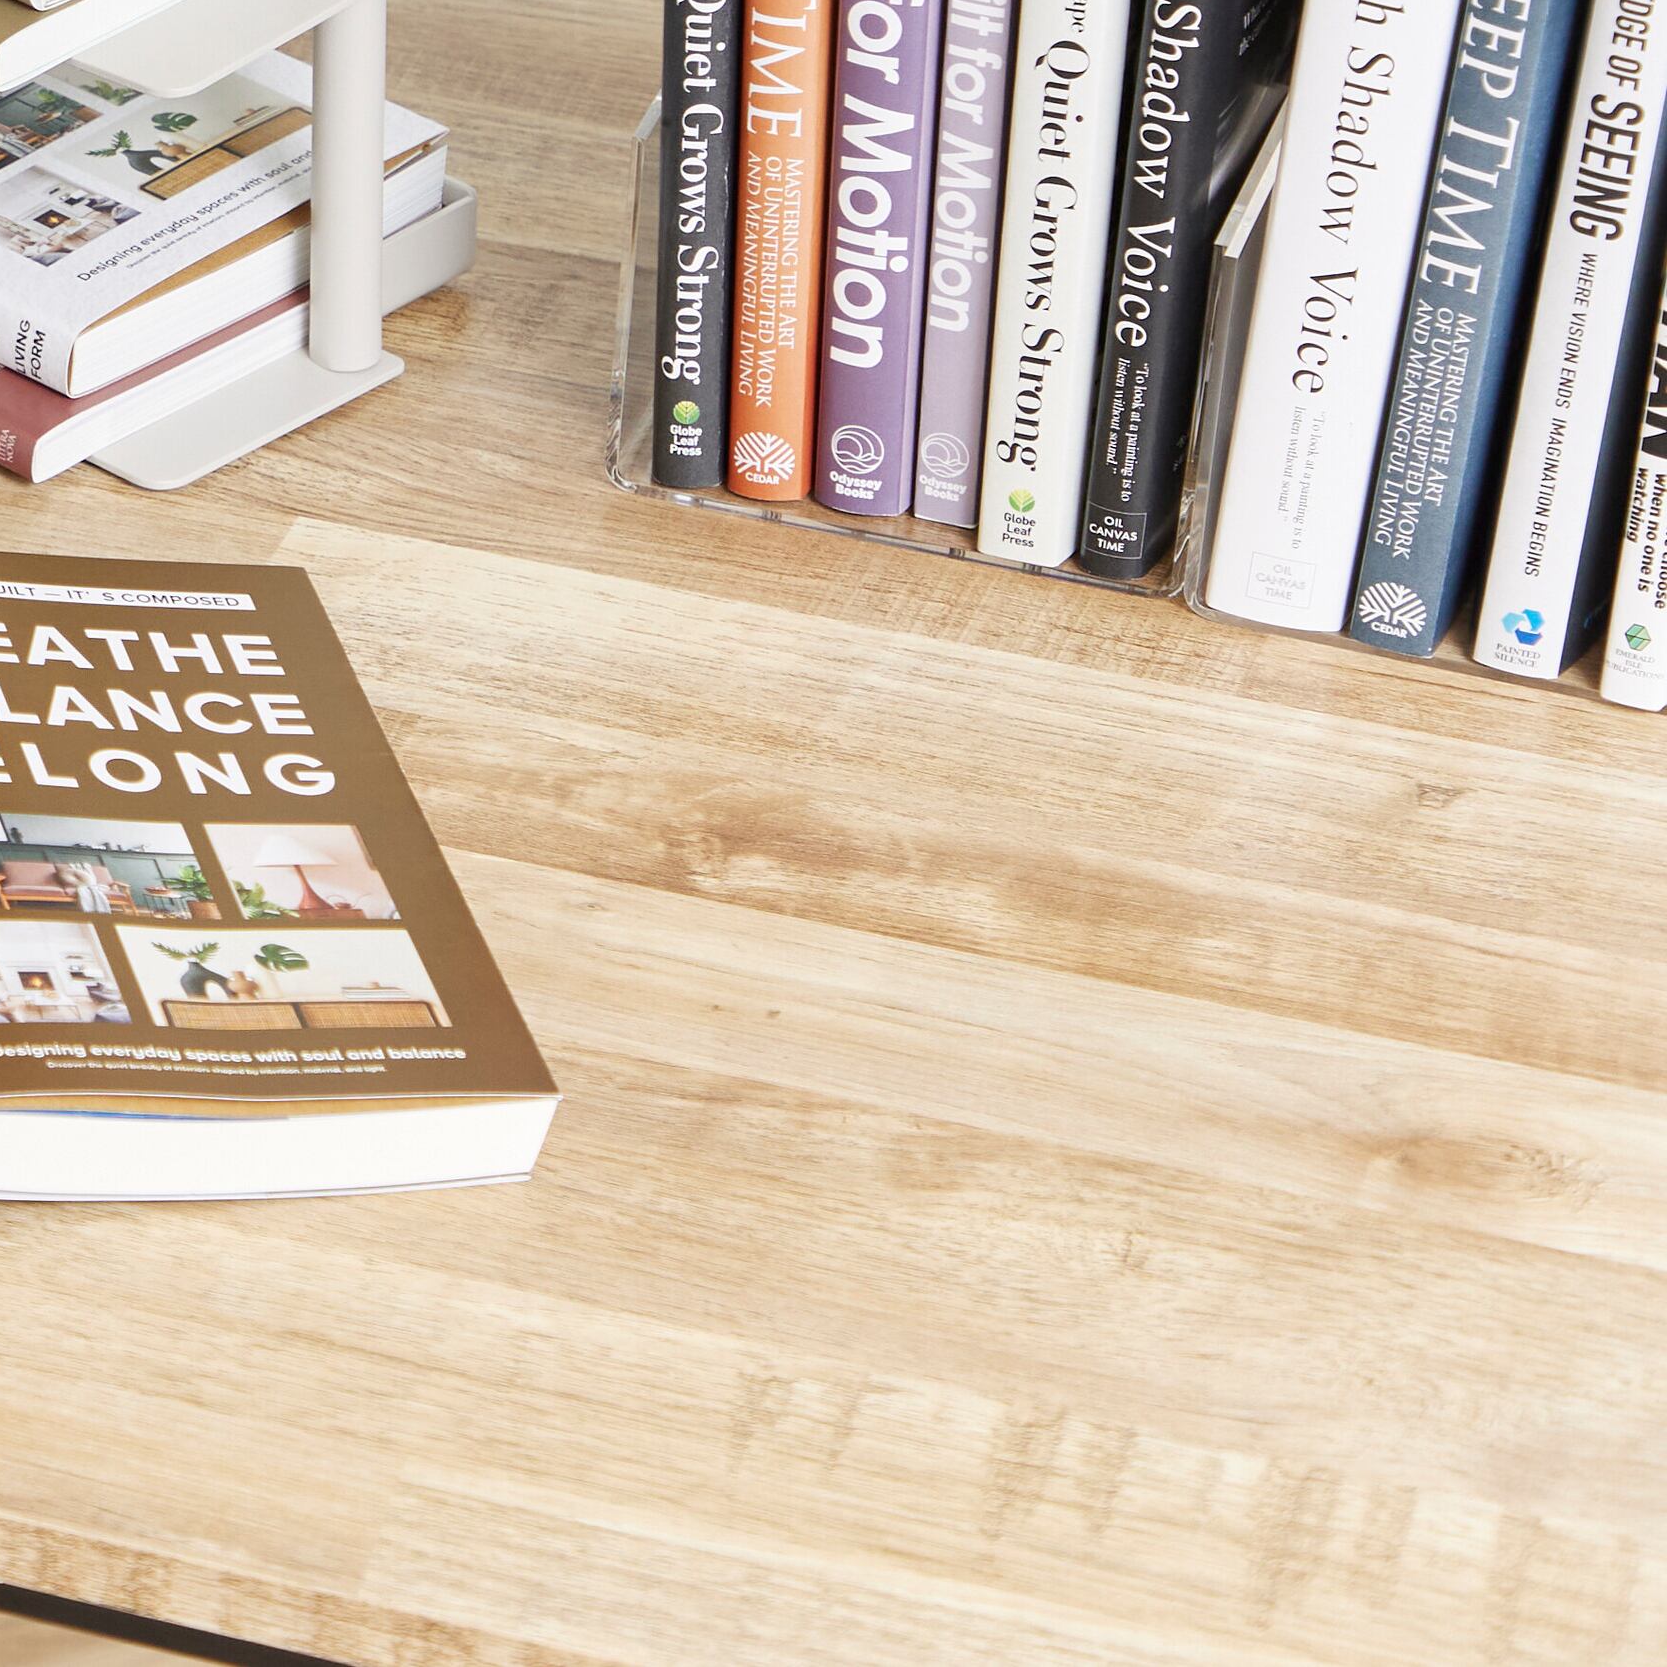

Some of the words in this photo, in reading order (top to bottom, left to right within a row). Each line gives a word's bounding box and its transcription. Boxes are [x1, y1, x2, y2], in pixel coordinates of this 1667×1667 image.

[944, 43, 1002, 126] for
[1606, 54, 1643, 93] OF
[1035, 39, 1091, 164] Quiet
[675, 103, 724, 236] Grows
[764, 155, 783, 181] OF
[1318, 45, 1396, 245] Shadow
[1569, 93, 1645, 241] SEEING
[746, 150, 763, 198] AND
[781, 158, 805, 270] MASTERING
[829, 93, 915, 369] Motion
[930, 131, 994, 334] Motion
[1419, 116, 1520, 296] TIME
[741, 202, 762, 337] MEANINGFUL
[757, 184, 782, 344] UNINTERRUPTED
[1025, 174, 1078, 312] Grows
[780, 273, 798, 304] THE
[1115, 217, 1176, 347] Voice
[1574, 253, 1597, 308] WHERE
[661, 244, 719, 386] Strong
[778, 307, 795, 349] ART
[1292, 266, 1358, 395] Voice
[1564, 311, 1587, 368] VISION
[738, 341, 756, 396] LIVING
[755, 346, 776, 408] WORK
[1555, 369, 1577, 410] ENDS
[996, 323, 1065, 473] Strong
[669, 444, 702, 456] Press
[670, 424, 702, 437] Globe
[673, 435, 699, 446] Leaf
[745, 474, 780, 485] CEDAR
[829, 471, 883, 491] Odyssey
[835, 484, 874, 500] Books
[1532, 416, 1568, 518] IMAGINATION
[1001, 533, 1035, 549] Press
[1003, 512, 1036, 527] Globe
[1006, 524, 1032, 537] Leaf
[1088, 523, 1138, 542] CANVAS
[1097, 537, 1125, 553] TIME
[1103, 515, 1124, 528] OIL
[1525, 518, 1548, 577] BEGINS
[121, 593, 239, 607] COMPOSED
[1371, 620, 1407, 638] CEDAR
